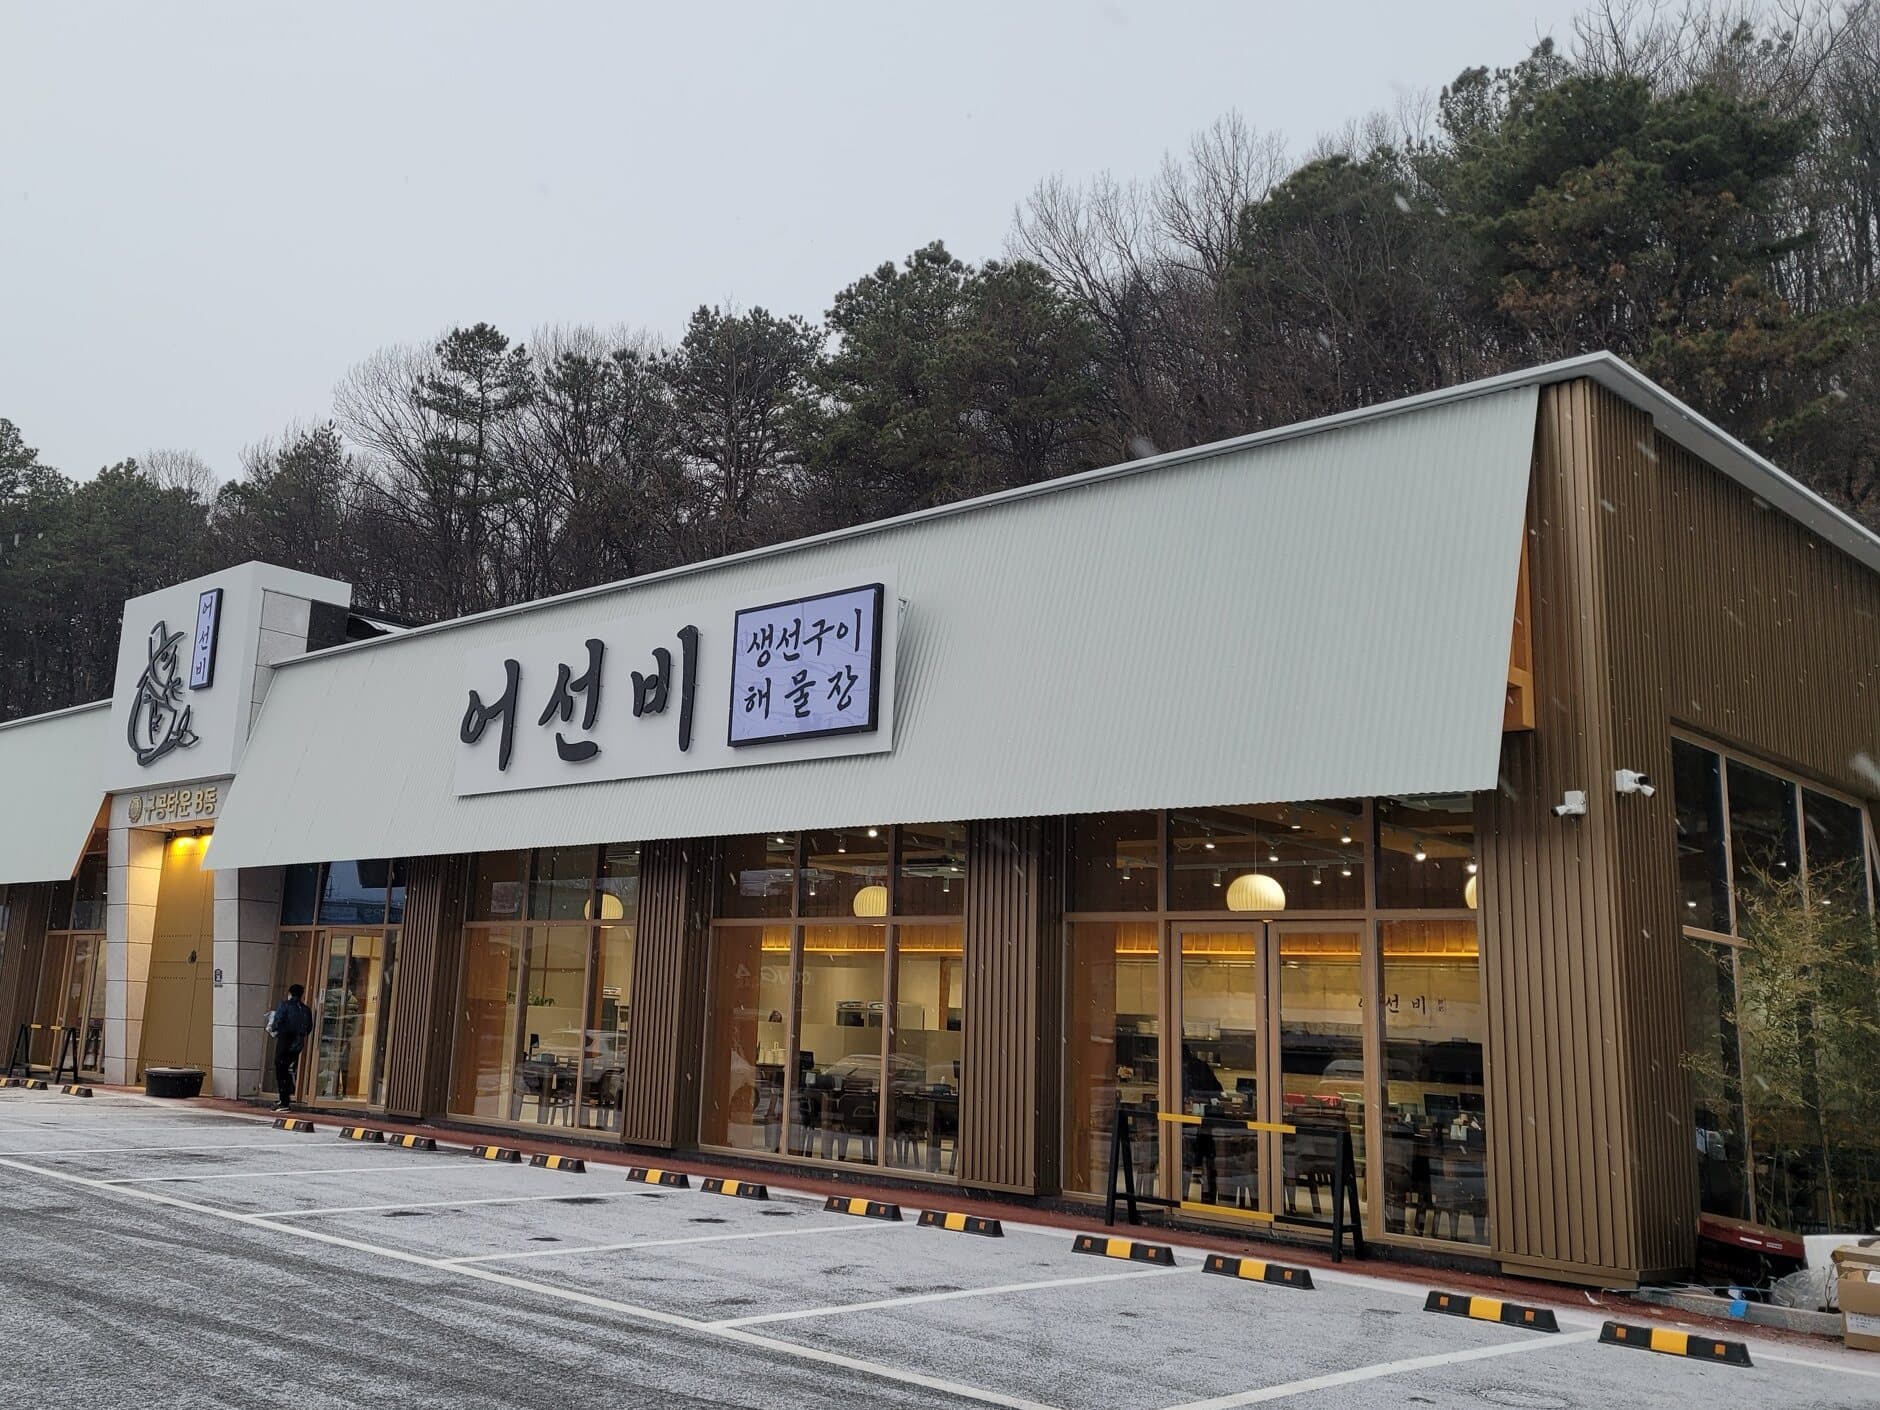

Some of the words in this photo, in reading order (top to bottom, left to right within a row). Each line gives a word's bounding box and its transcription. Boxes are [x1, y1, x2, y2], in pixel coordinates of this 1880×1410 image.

[195, 594, 214, 681] 어선비
[746, 607, 863, 669] 생선구이
[459, 624, 700, 772] 어선비
[1358, 993, 1426, 1015] 선비
